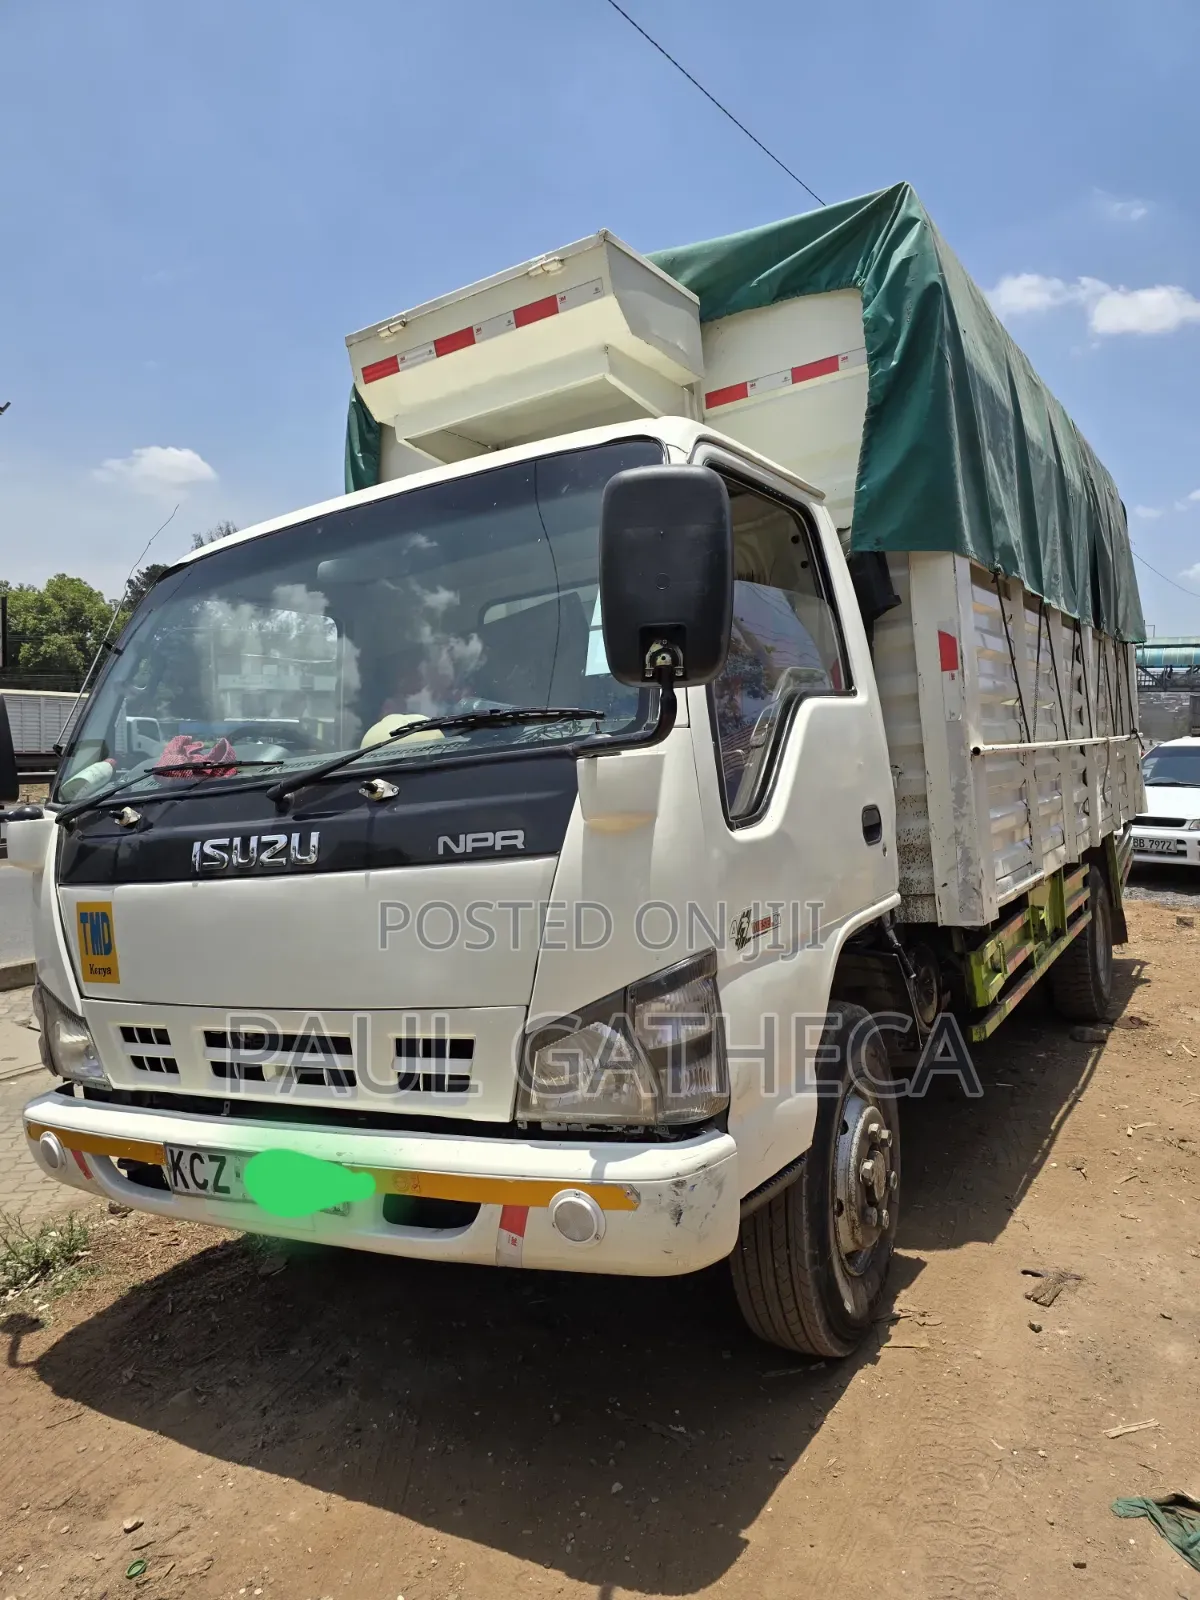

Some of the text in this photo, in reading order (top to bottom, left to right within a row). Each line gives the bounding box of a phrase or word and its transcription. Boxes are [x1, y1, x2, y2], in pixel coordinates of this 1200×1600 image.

[191, 831, 320, 872] ISUZU
[438, 830, 525, 855] NPR
[80, 911, 112, 956] TMD
[89, 963, 112, 977] Kenya
[168, 1148, 231, 1195] KCZ
